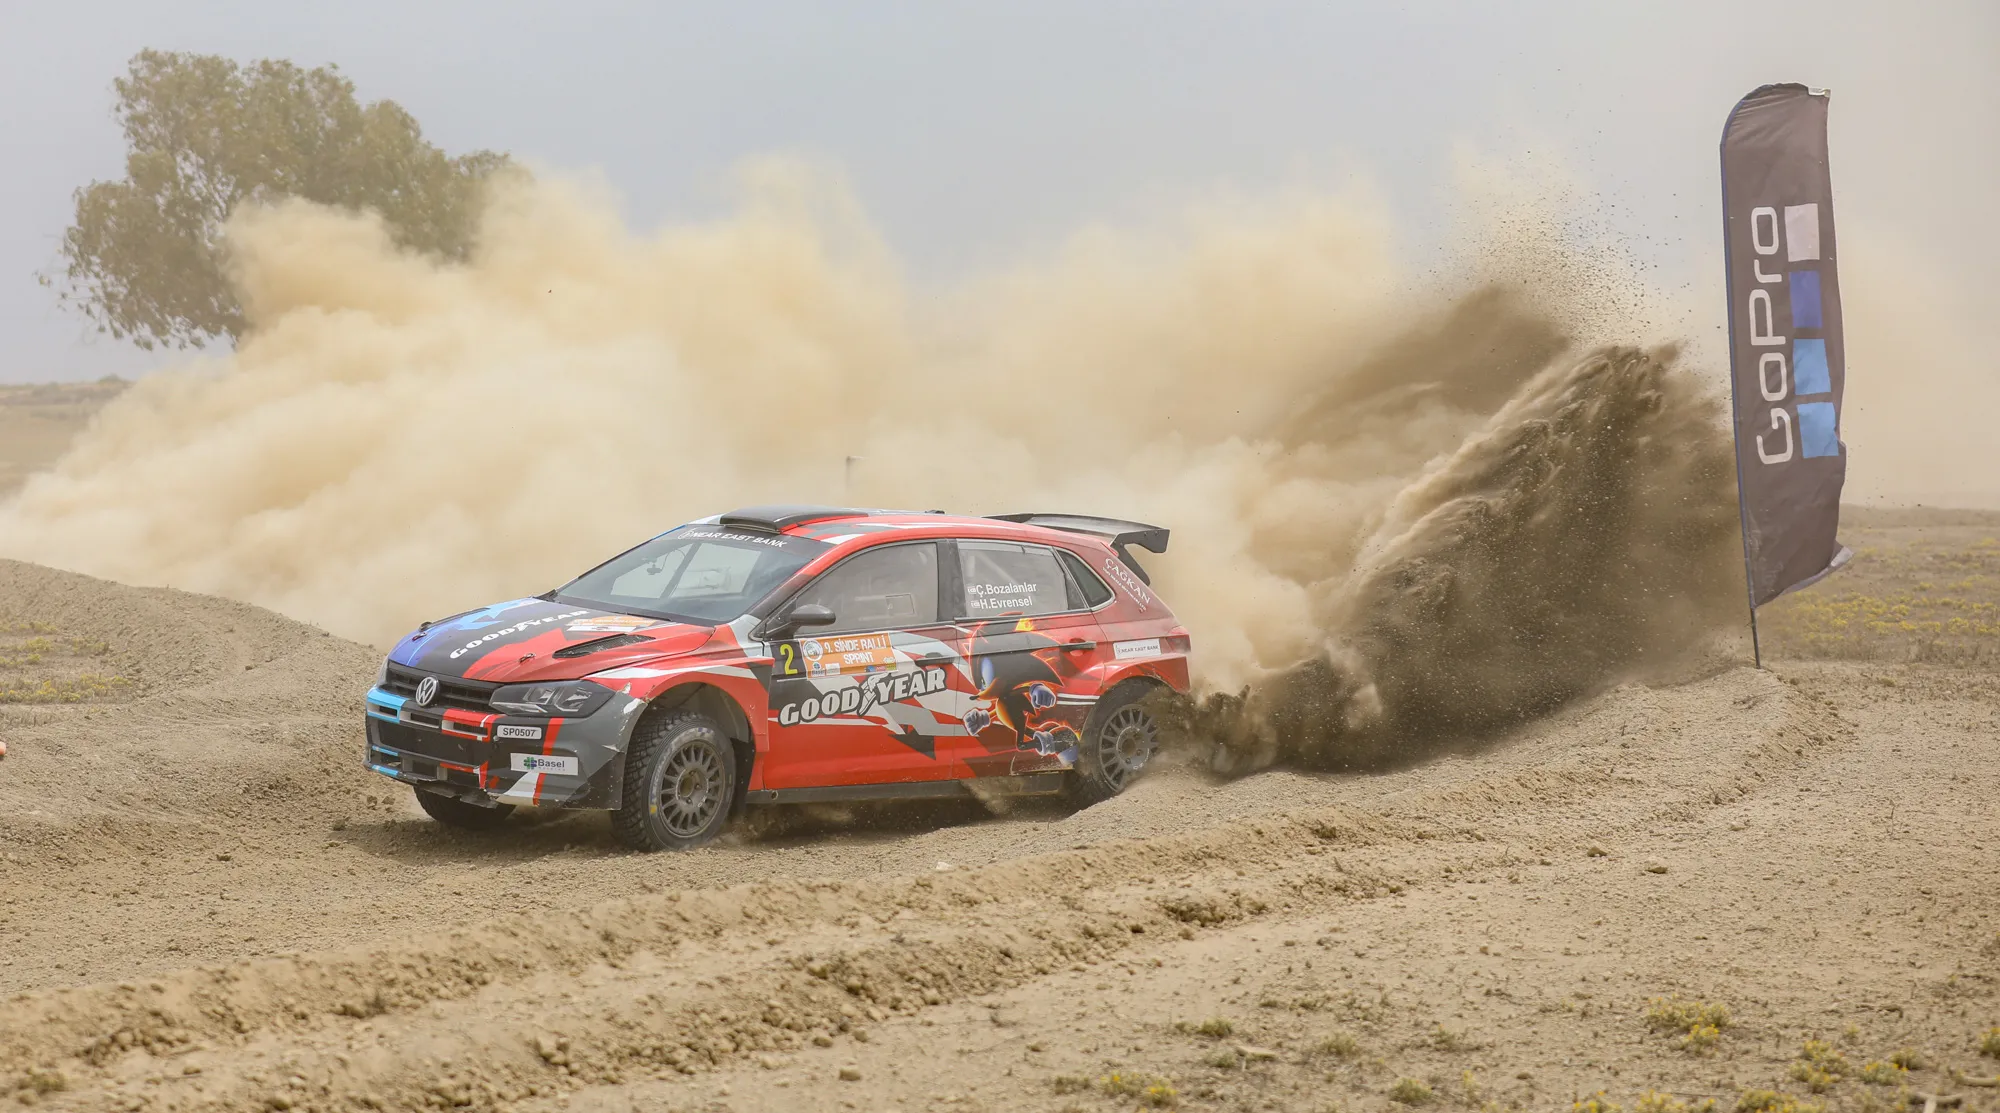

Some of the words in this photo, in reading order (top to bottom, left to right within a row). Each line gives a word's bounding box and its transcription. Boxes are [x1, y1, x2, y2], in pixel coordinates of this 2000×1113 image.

[1749, 206, 1794, 465] GoPro
[691, 531, 721, 539] NEAR
[721, 533, 755, 542] EAST
[754, 537, 787, 548] BANK
[976, 582, 1037, 598] Ç.Bozalanlar
[980, 596, 1033, 609] H.Evrensel
[449, 609, 590, 659] GOODYEAR
[824, 642, 834, 654] 9.
[834, 638, 859, 653] SİNDE
[780, 643, 798, 675] 2
[843, 651, 875, 665] SPRINT
[502, 727, 536, 737] SP0507
[537, 758, 565, 768] Basel
